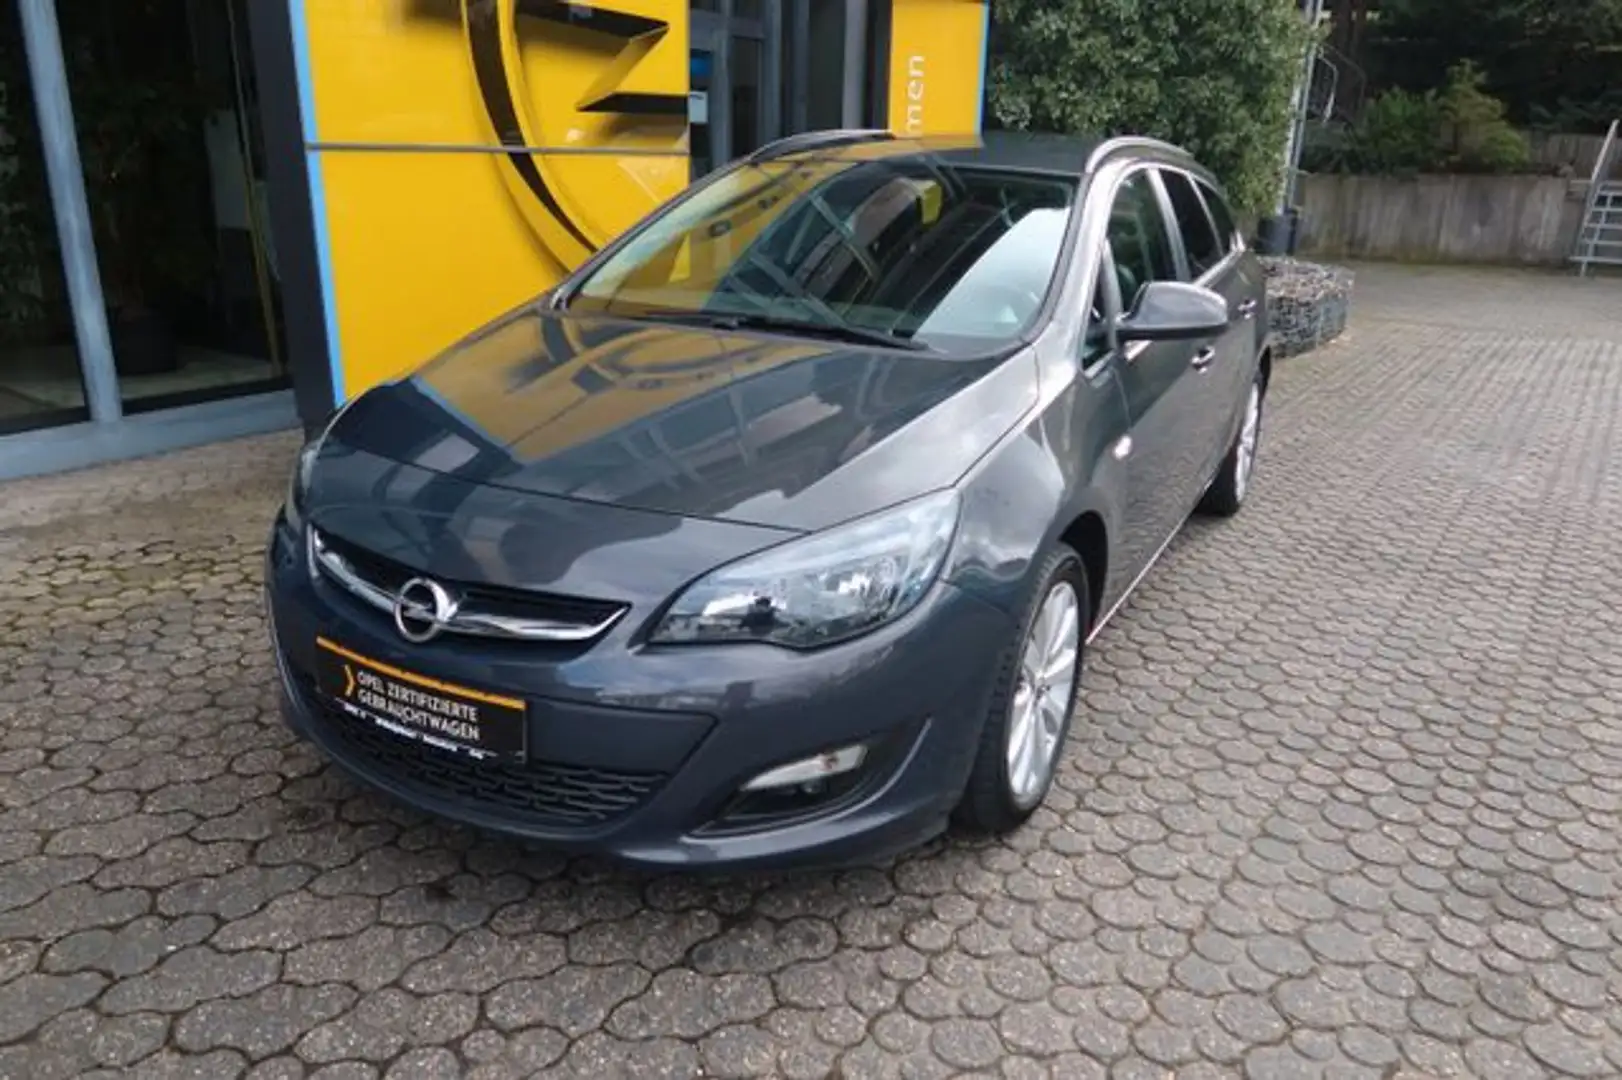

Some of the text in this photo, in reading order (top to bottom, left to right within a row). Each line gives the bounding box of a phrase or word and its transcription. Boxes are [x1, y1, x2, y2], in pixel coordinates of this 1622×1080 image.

[357, 671, 479, 722] OPEL ZERTIFIZIERTE
[358, 690, 480, 740] GEBRAUCHTWAGEN
